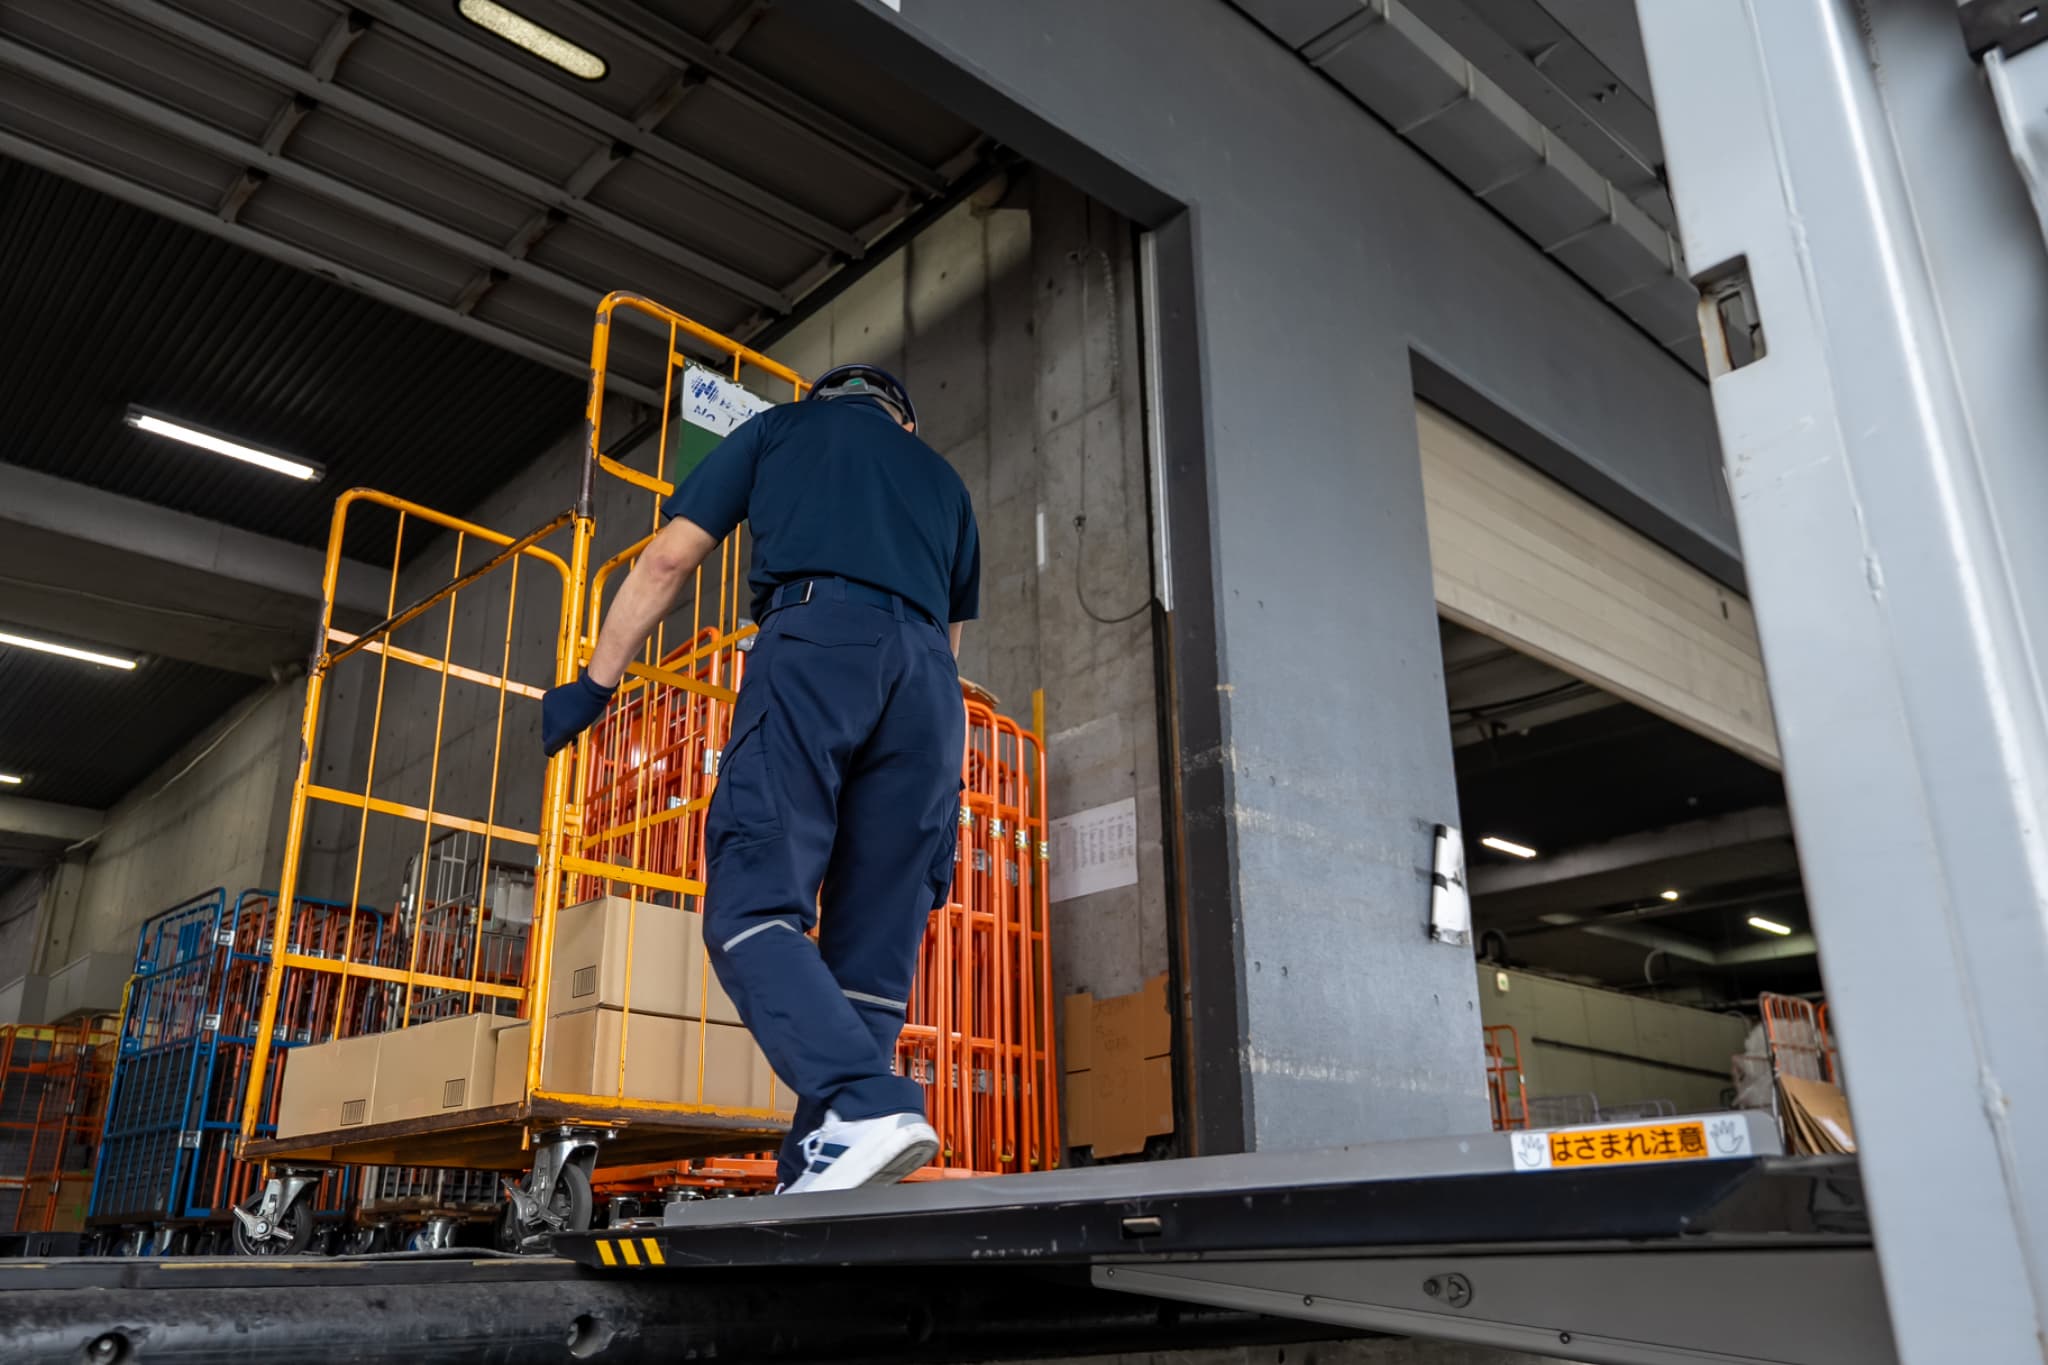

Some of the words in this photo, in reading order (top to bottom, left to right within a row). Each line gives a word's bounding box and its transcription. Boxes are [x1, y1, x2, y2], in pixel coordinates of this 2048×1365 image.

[1550, 1126, 1705, 1161] はさまれ注意
